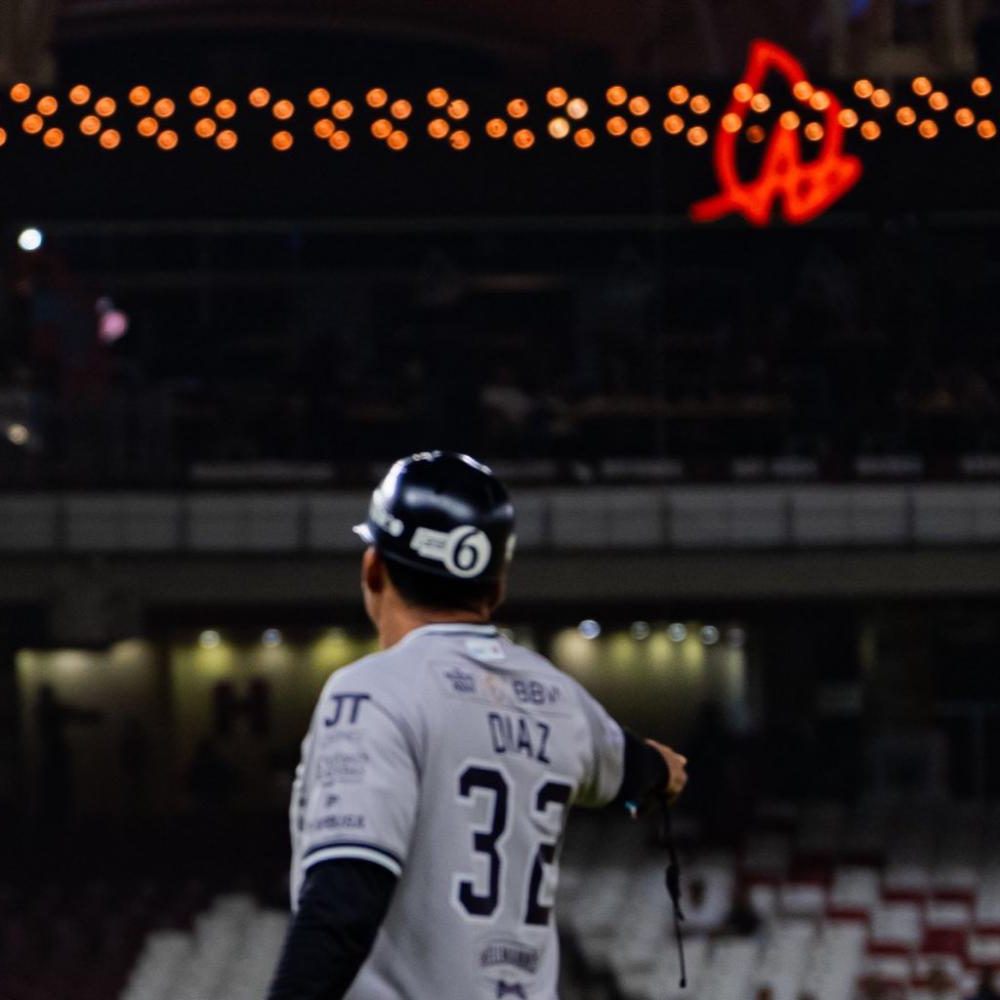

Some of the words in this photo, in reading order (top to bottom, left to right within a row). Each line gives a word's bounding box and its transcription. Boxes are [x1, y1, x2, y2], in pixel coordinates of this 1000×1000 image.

[454, 527, 480, 571] 6
[325, 693, 371, 727] JT
[488, 712, 551, 764] DIAZ
[459, 766, 572, 926] 32
